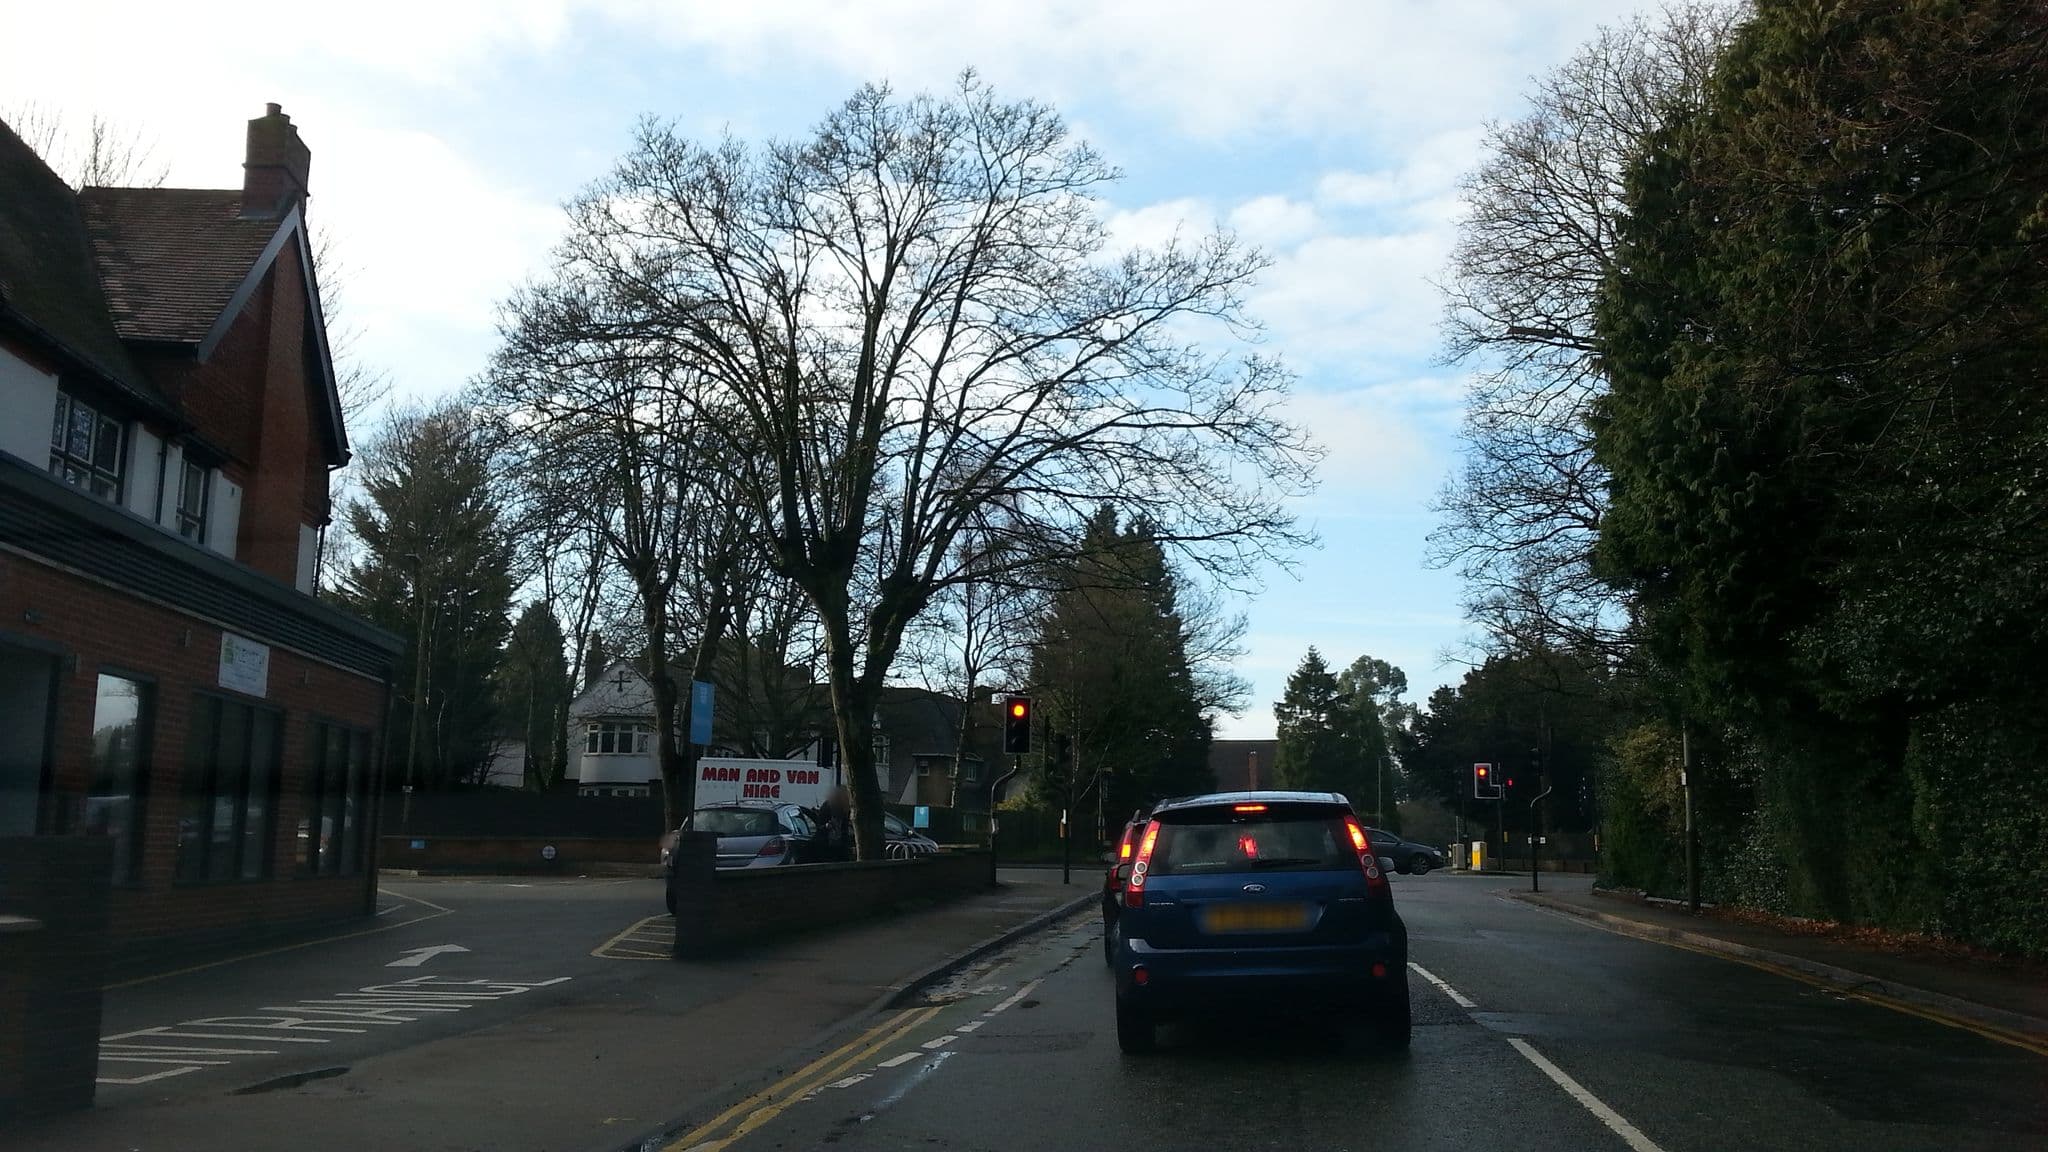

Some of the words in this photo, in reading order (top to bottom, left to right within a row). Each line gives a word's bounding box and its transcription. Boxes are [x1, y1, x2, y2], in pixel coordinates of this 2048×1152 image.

[702, 767, 740, 781] MAN
[747, 769, 780, 783] AND
[787, 770, 819, 784] VAN
[743, 784, 780, 798] HIRE
